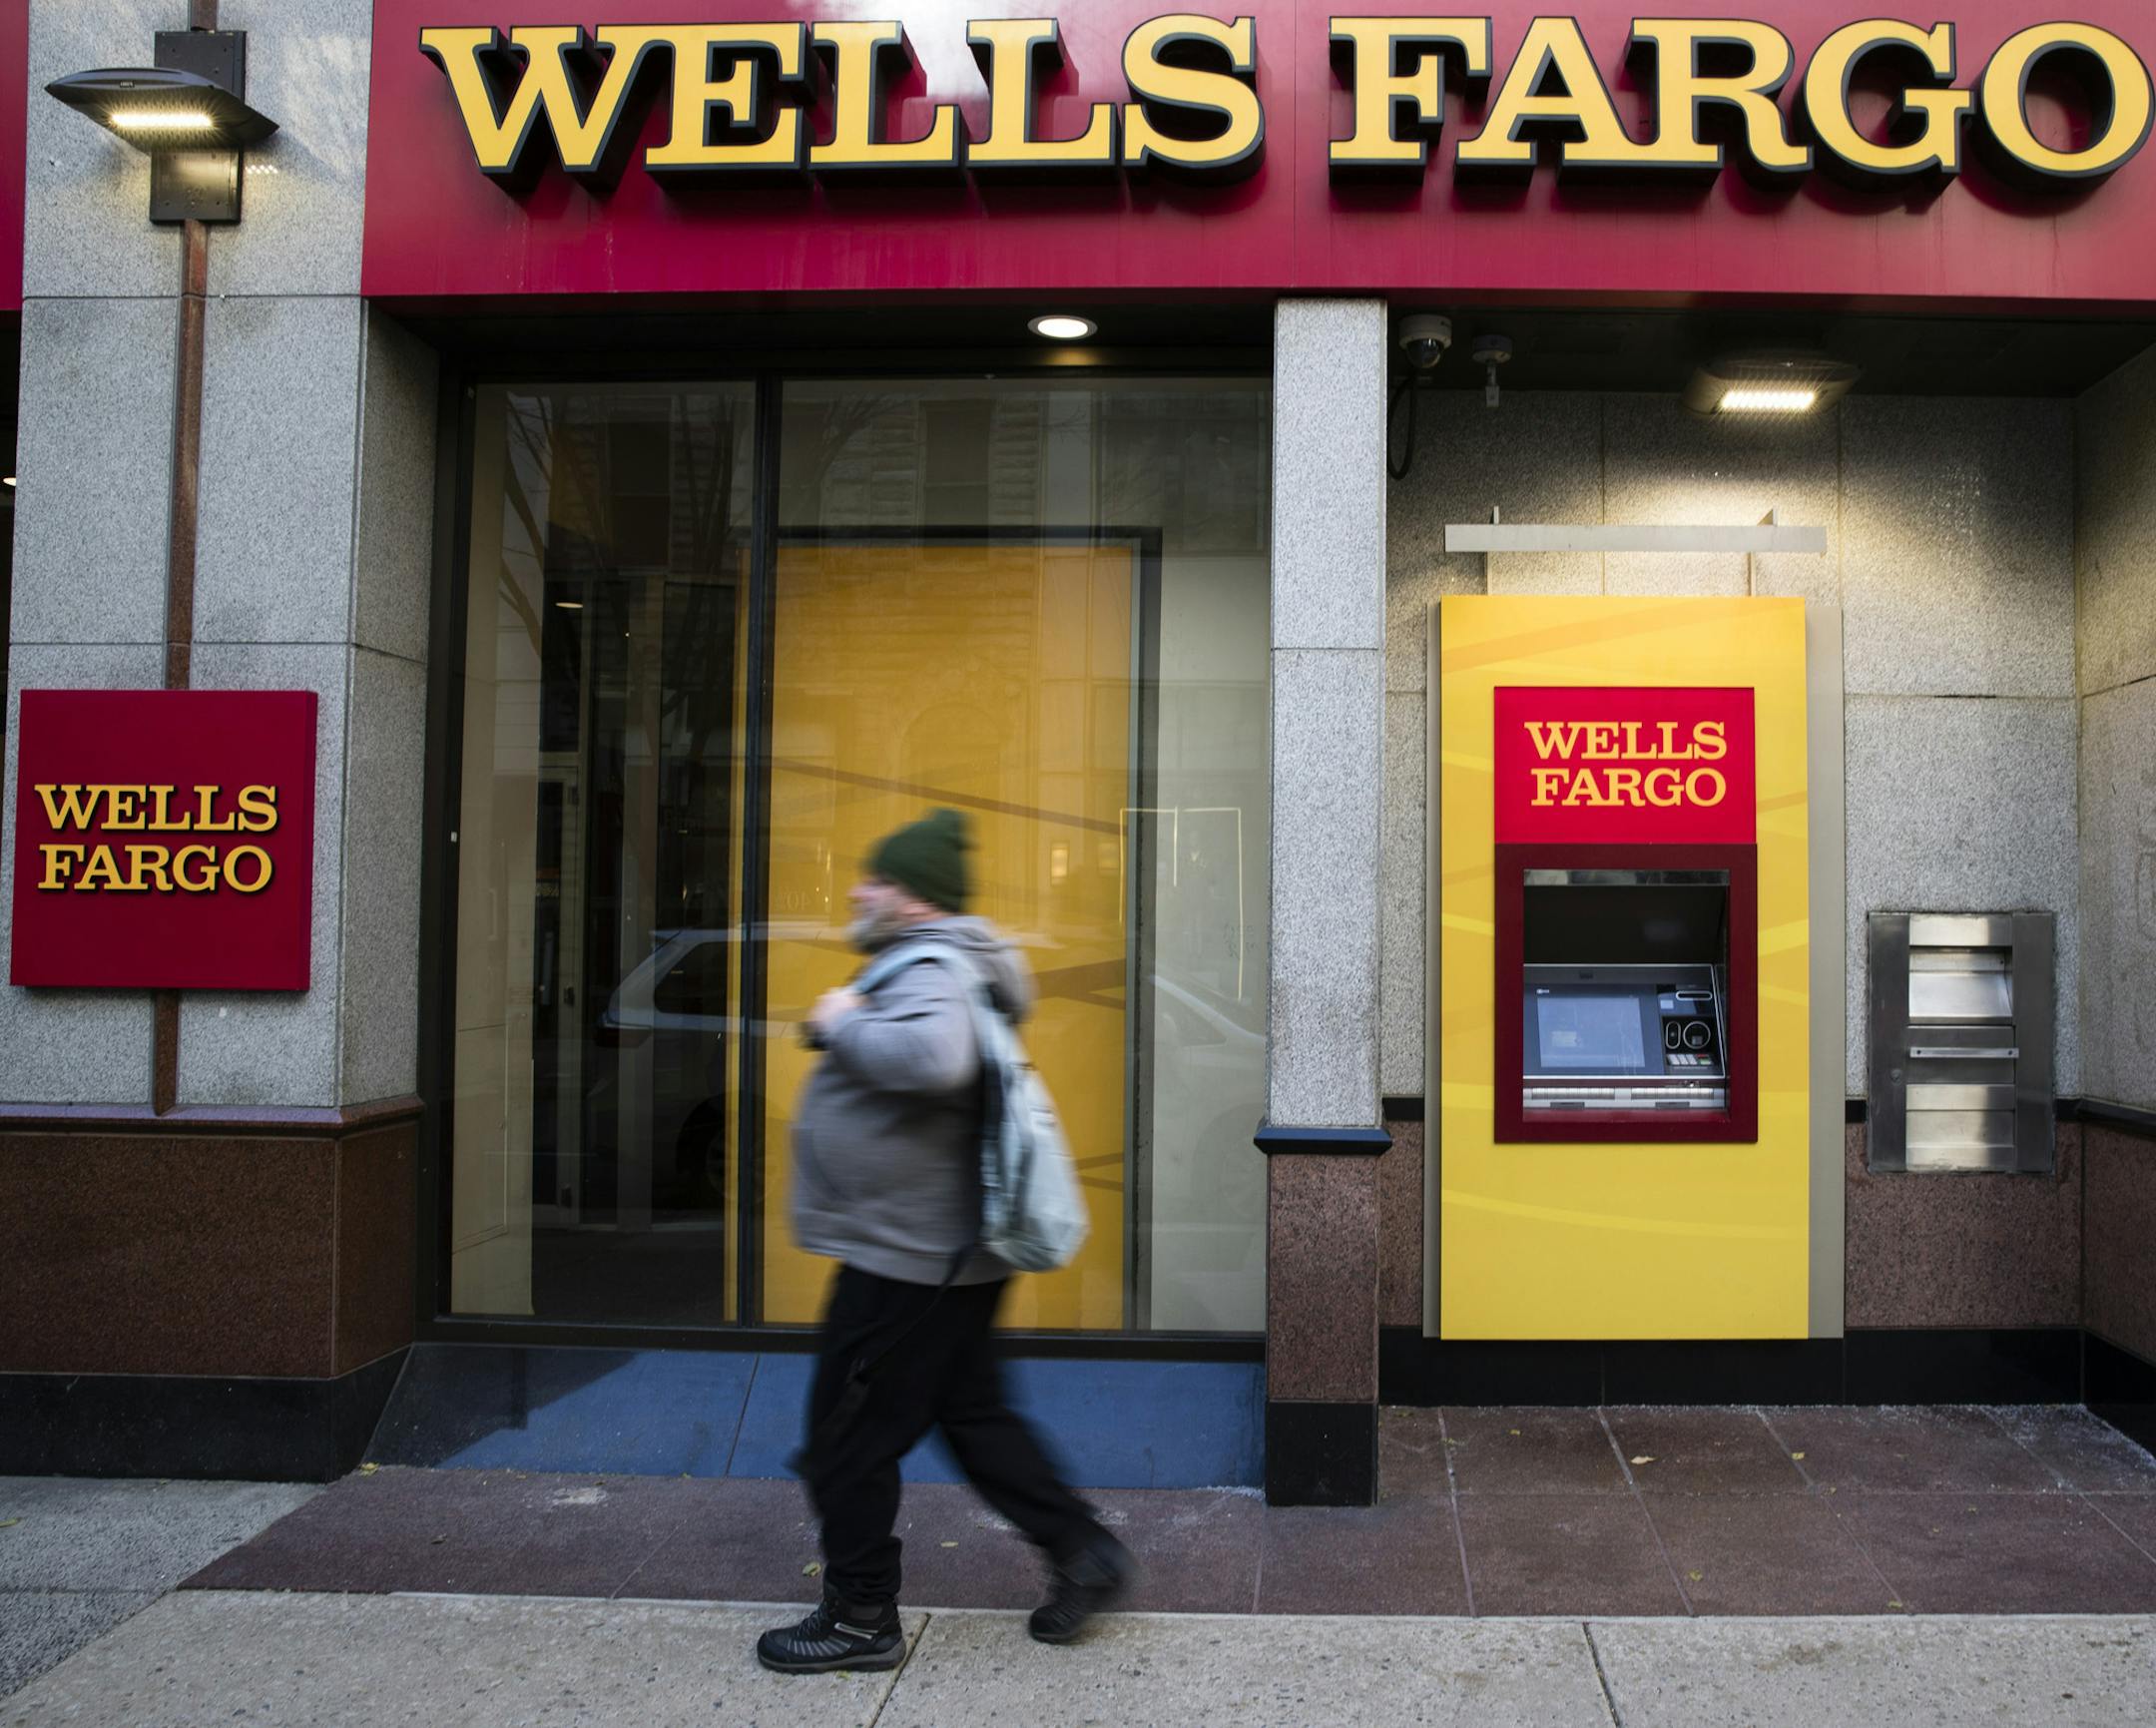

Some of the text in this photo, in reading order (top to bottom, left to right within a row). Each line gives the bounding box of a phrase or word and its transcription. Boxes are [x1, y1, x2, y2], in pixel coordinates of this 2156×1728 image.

[420, 15, 2154, 176] WELLS FARGO
[1524, 721, 1727, 760] WELLS
[34, 784, 278, 833] WELLS
[1531, 768, 1726, 807] FARGO
[38, 844, 273, 892] FARGO
